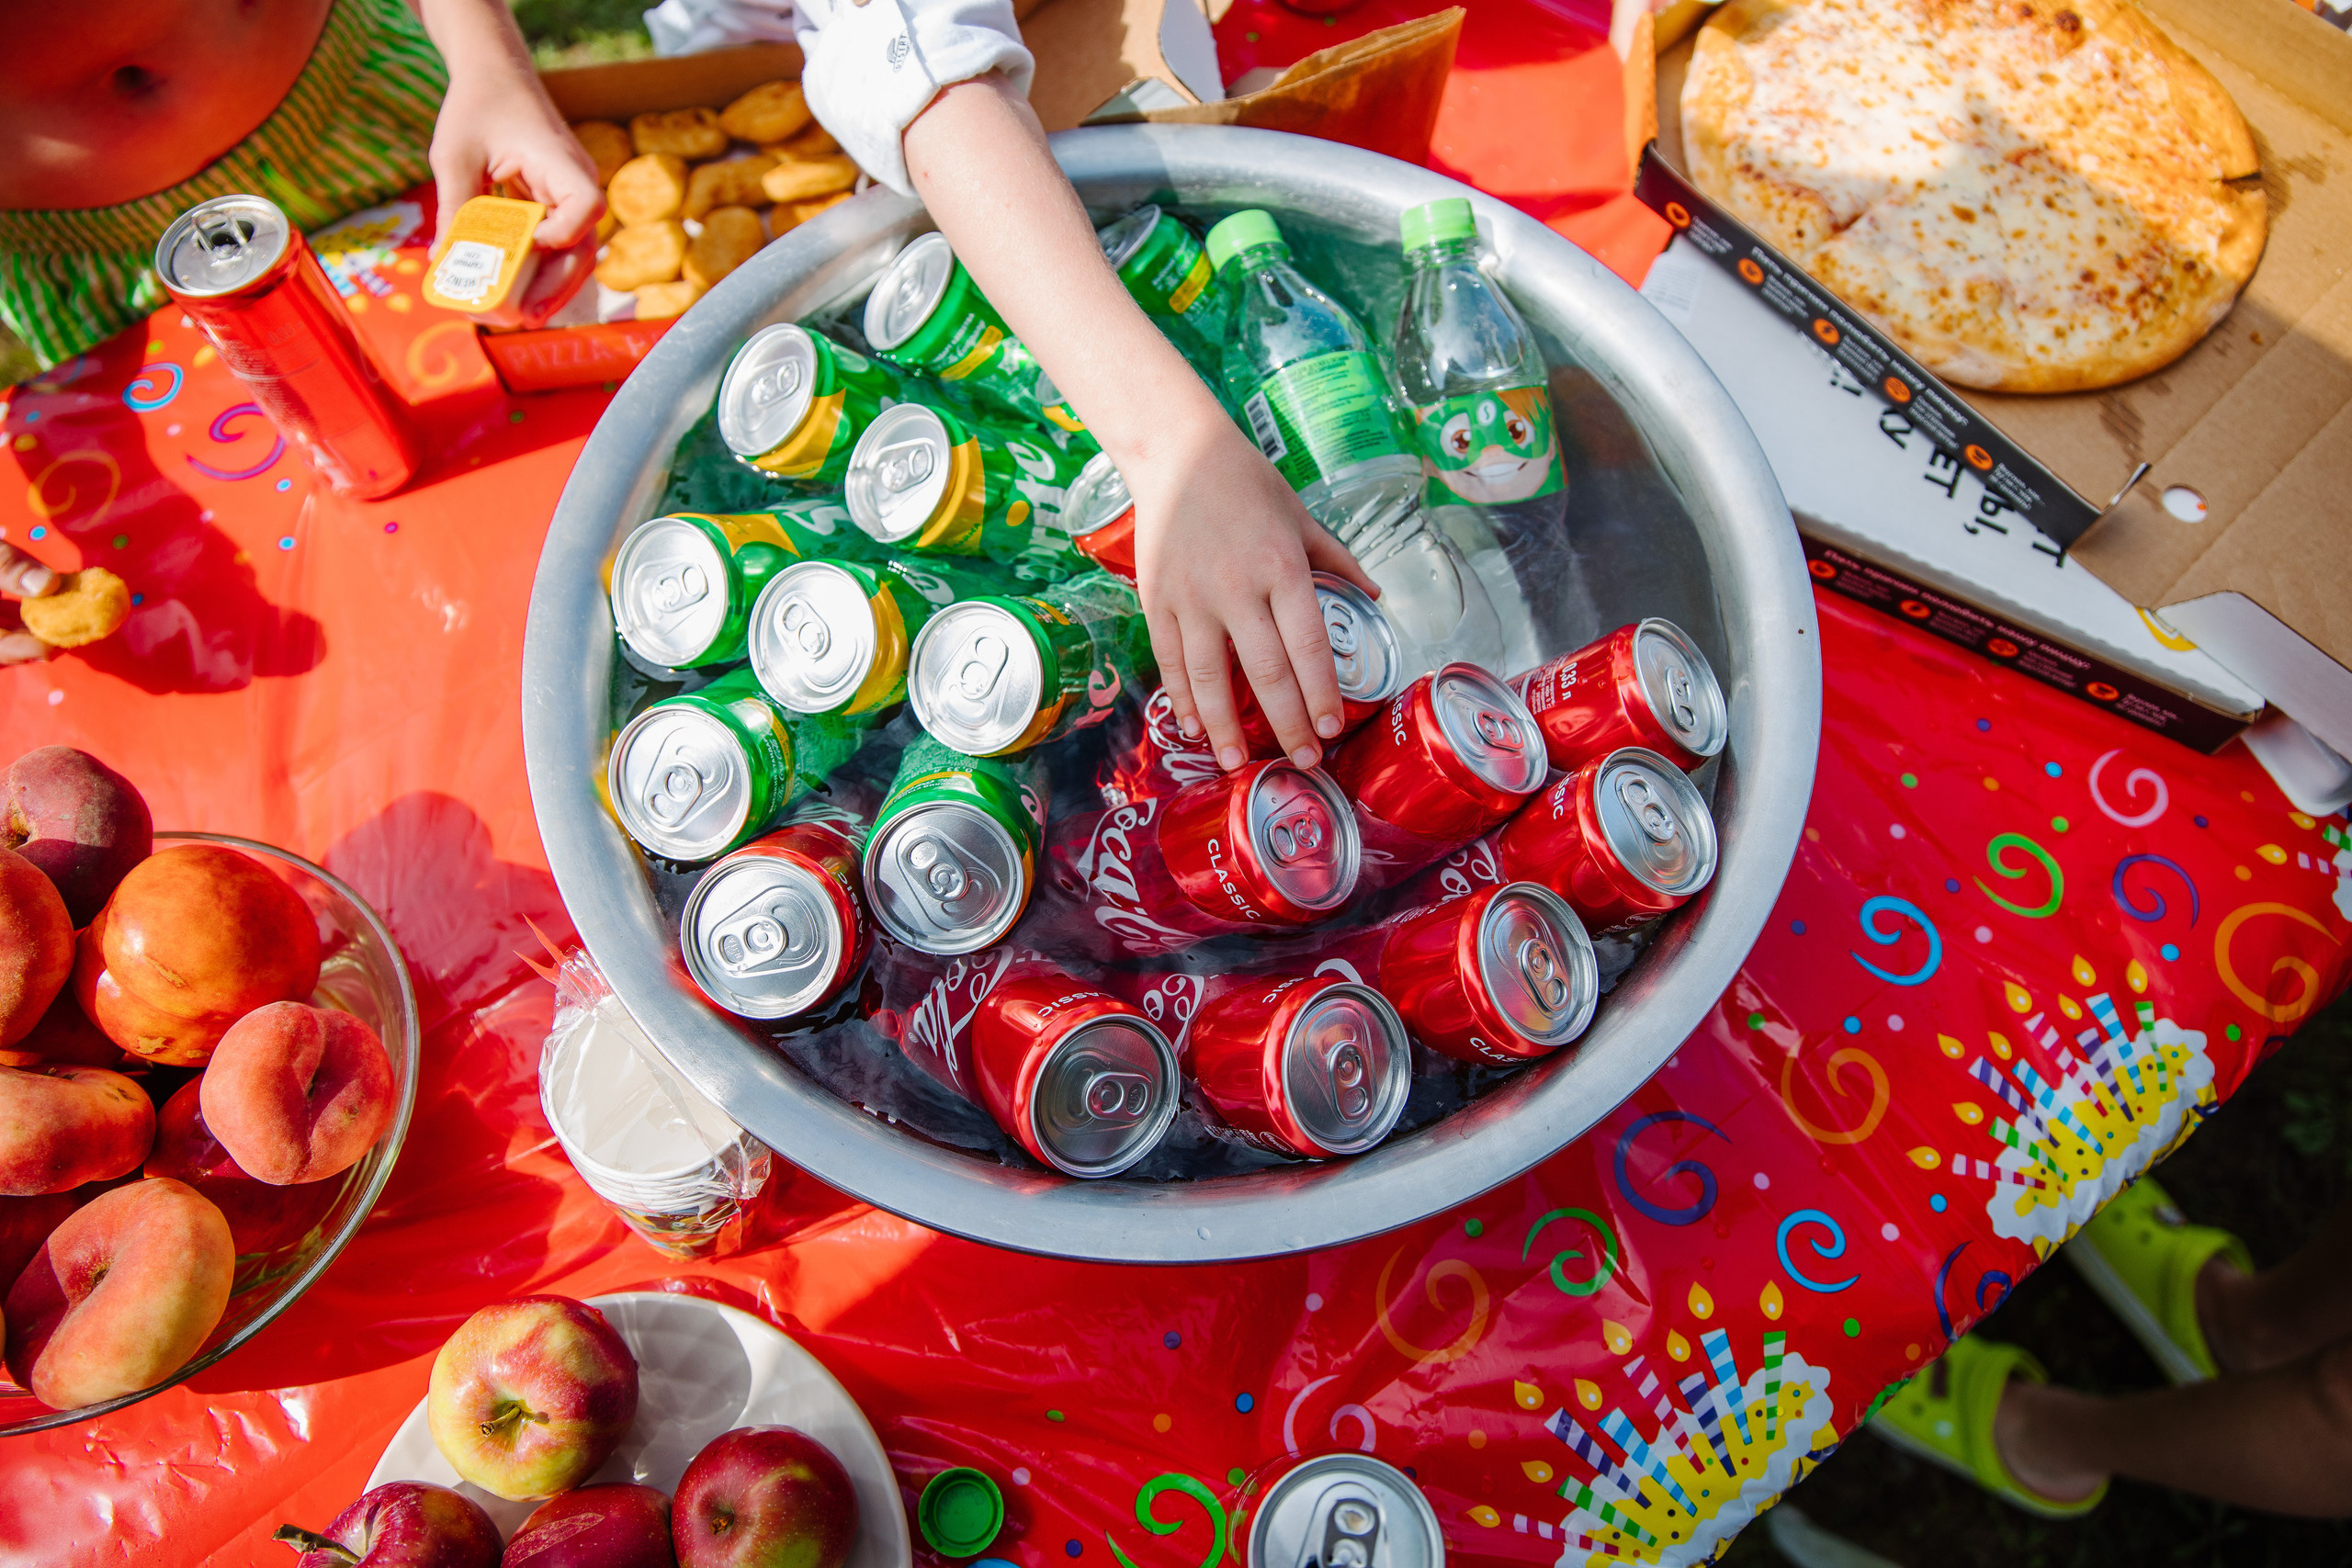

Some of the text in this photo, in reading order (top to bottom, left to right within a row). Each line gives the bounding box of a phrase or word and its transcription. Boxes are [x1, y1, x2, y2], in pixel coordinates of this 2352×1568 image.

[1559, 661, 1577, 701] 0,33 л
[1391, 694, 1407, 746] ASSIC
[1207, 838, 1261, 919] CLASSIC
